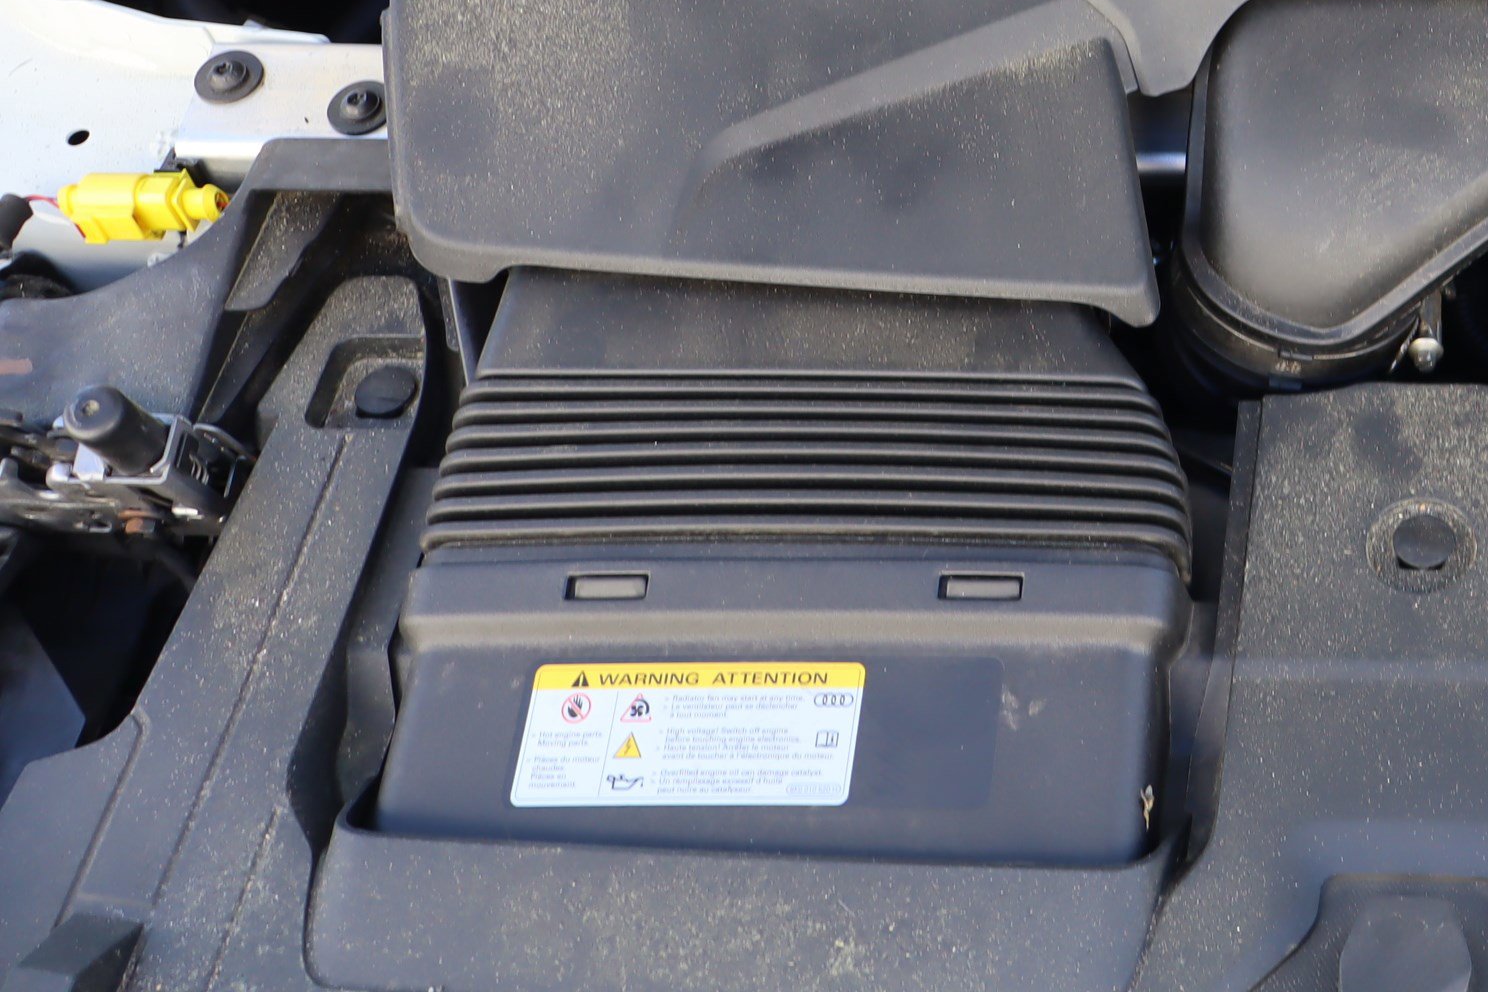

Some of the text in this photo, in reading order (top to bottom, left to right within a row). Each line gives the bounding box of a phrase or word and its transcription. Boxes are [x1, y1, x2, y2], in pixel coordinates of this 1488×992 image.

[599, 671, 829, 686] WARNING ATTENTION
[672, 694, 704, 702] Radiator
[707, 694, 720, 702] fan
[722, 695, 738, 703] may
[740, 694, 758, 702] start
[760, 694, 766, 702] at
[770, 695, 782, 703] any
[582, 731, 602, 740] parts
[666, 727, 684, 736] High
[721, 727, 747, 735] Switch
[749, 727, 760, 735] off
[761, 727, 788, 736] engine
[692, 736, 726, 745] touching
[728, 736, 756, 745] engine
[660, 768, 699, 776] Overfilled
[700, 768, 728, 777] engine
[730, 768, 740, 776] oil
[740, 768, 754, 776] can
[757, 768, 788, 777] damage
